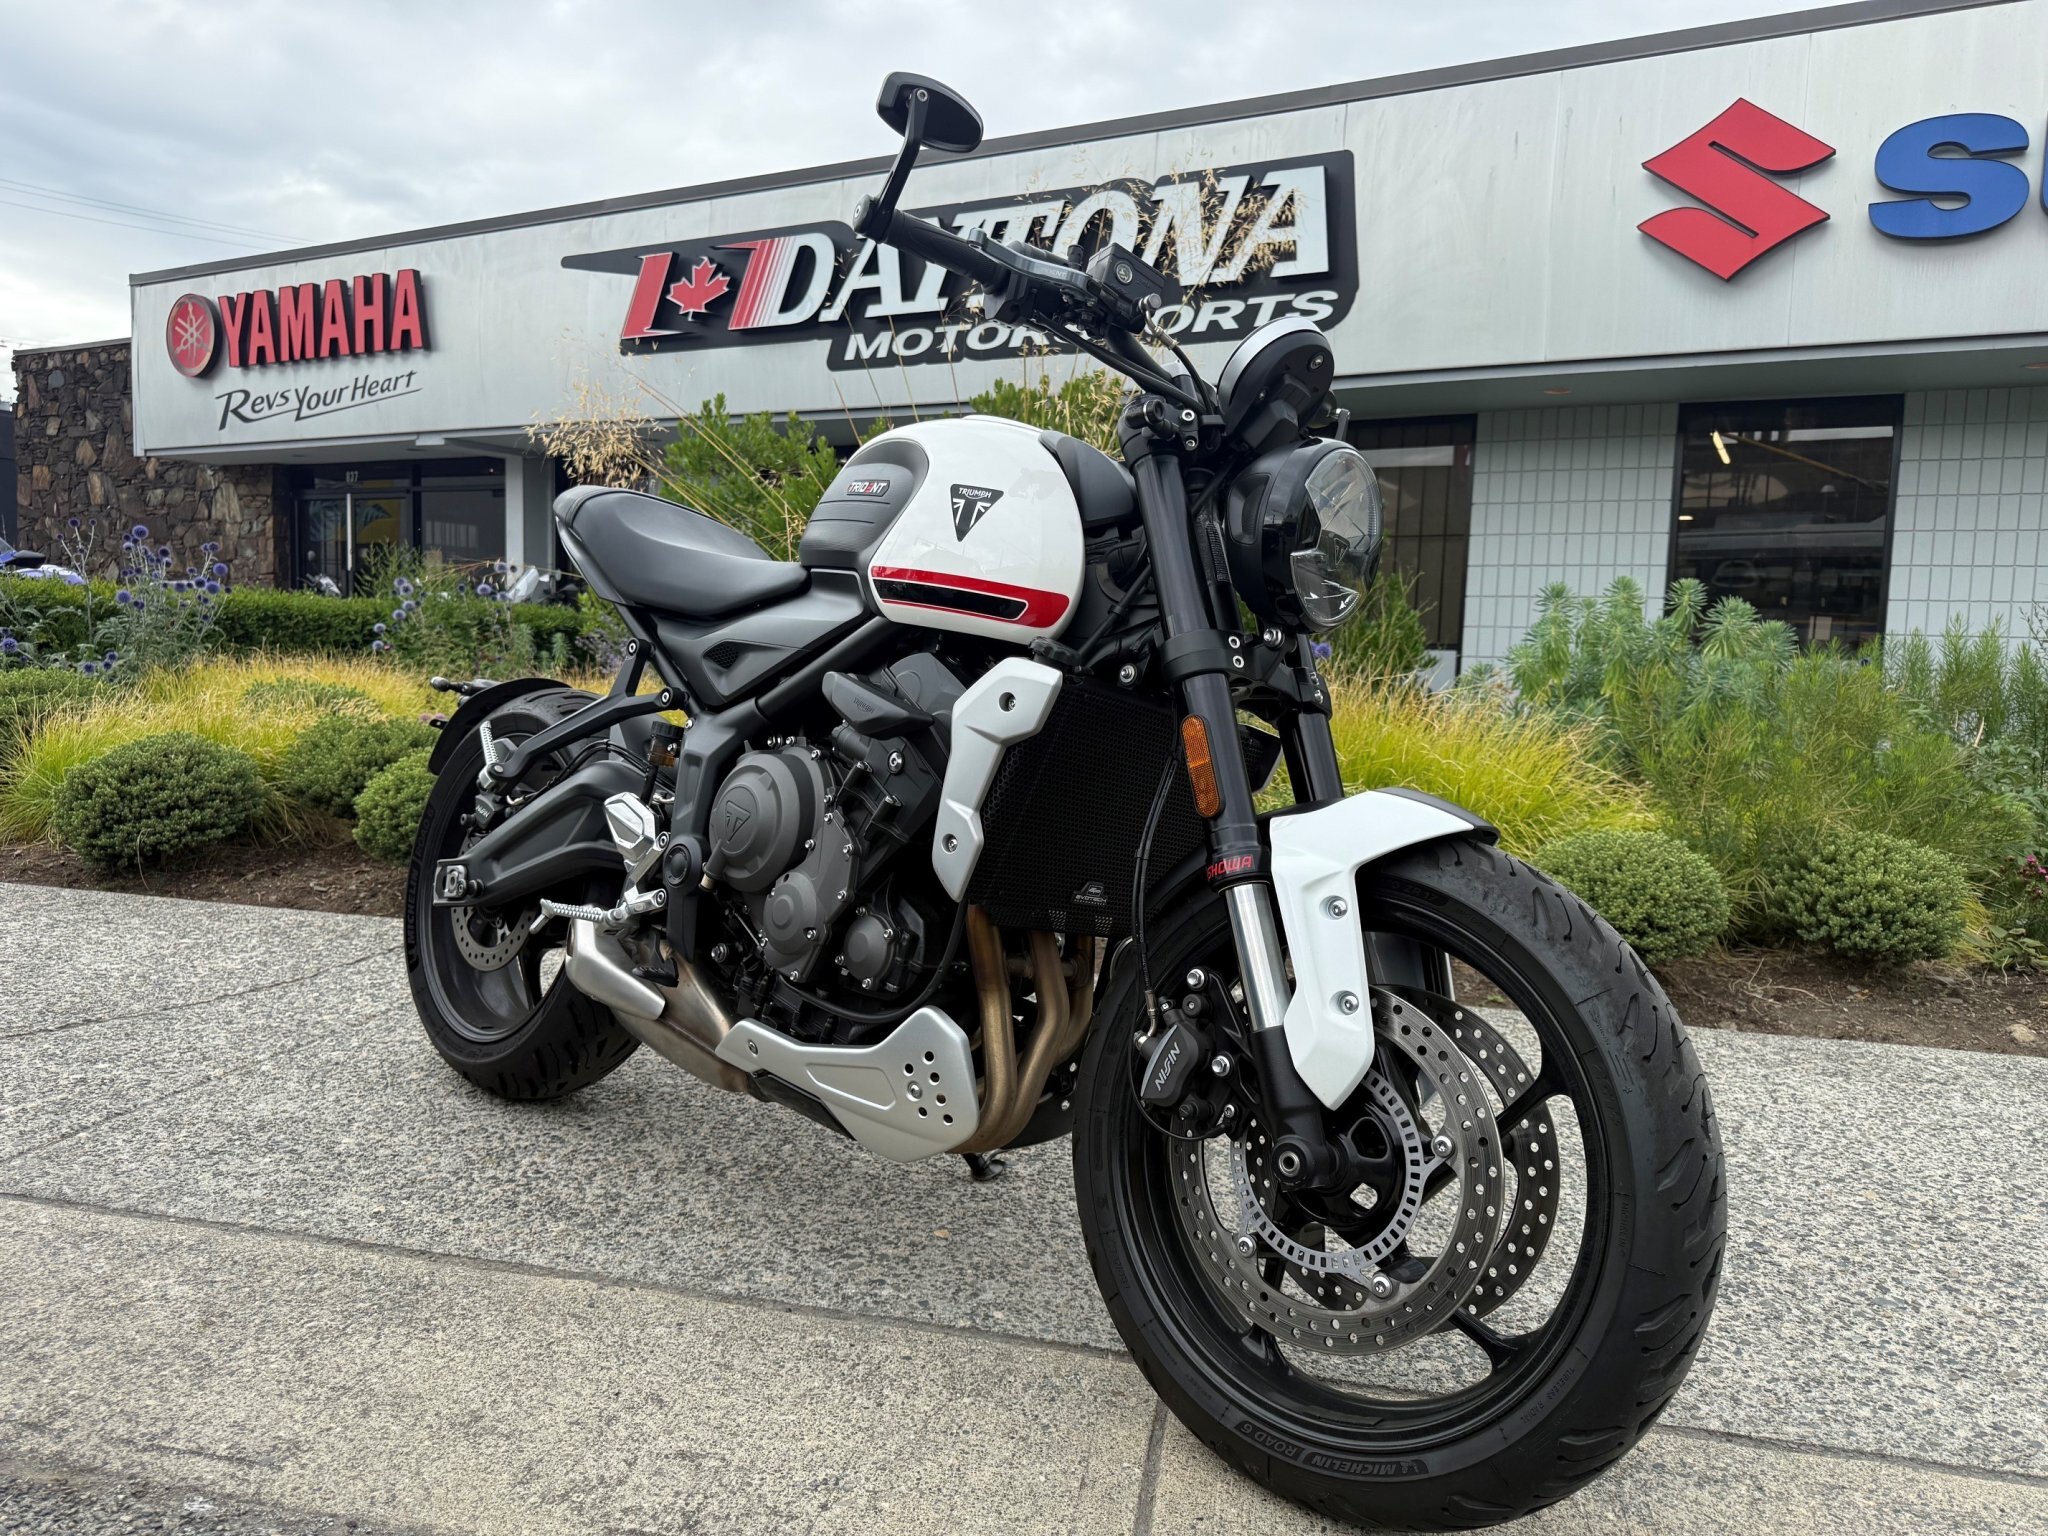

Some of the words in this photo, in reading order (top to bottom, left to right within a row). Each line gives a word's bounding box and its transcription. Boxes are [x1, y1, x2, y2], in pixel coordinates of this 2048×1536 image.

[1868, 112, 2048, 243] S
[218, 268, 428, 368] YAMAHA
[843, 290, 1340, 361] MOTORORTS
[215, 388, 292, 431] Revs
[294, 384, 352, 422] Your
[351, 369, 418, 405] Heart
[847, 481, 888, 494] TRIDENT
[958, 487, 992, 499] TRIUMPH
[1206, 855, 1254, 880] SHOWA
[1240, 1422, 1253, 1435] 6
[1254, 1430, 1298, 1458] ROAD
[1311, 1454, 1397, 1476] MICHELIN
